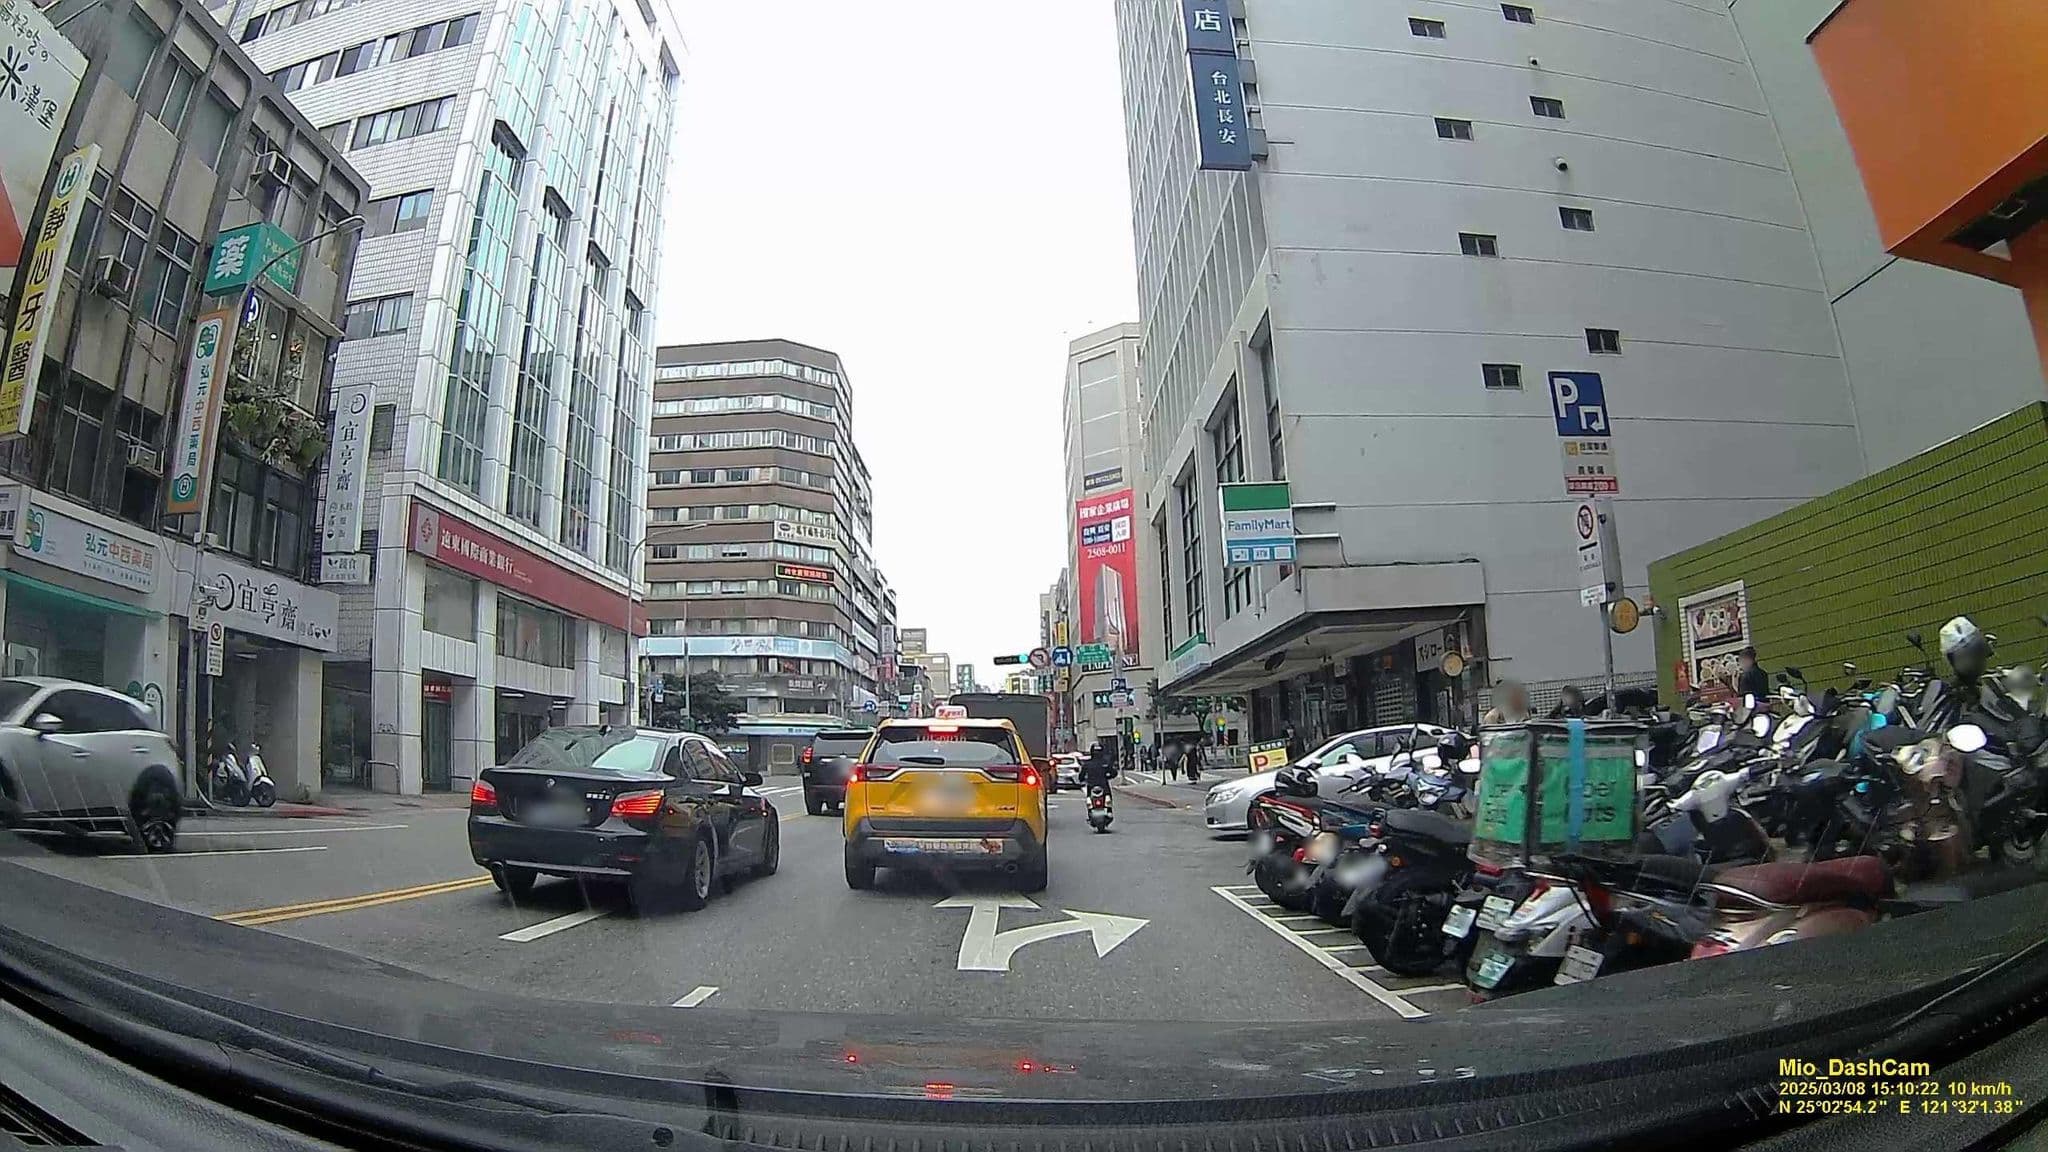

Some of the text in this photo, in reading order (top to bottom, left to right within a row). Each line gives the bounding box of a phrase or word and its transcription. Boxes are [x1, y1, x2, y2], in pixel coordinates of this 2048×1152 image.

[1193, 9, 1221, 32] 店
[1212, 71, 1237, 144] 台北長安
[8, 200, 69, 383] 靜心牙醫
[1553, 377, 1579, 419] P
[1228, 519, 1291, 532] FamilyMart
[86, 533, 153, 570] 弘元中西藥局
